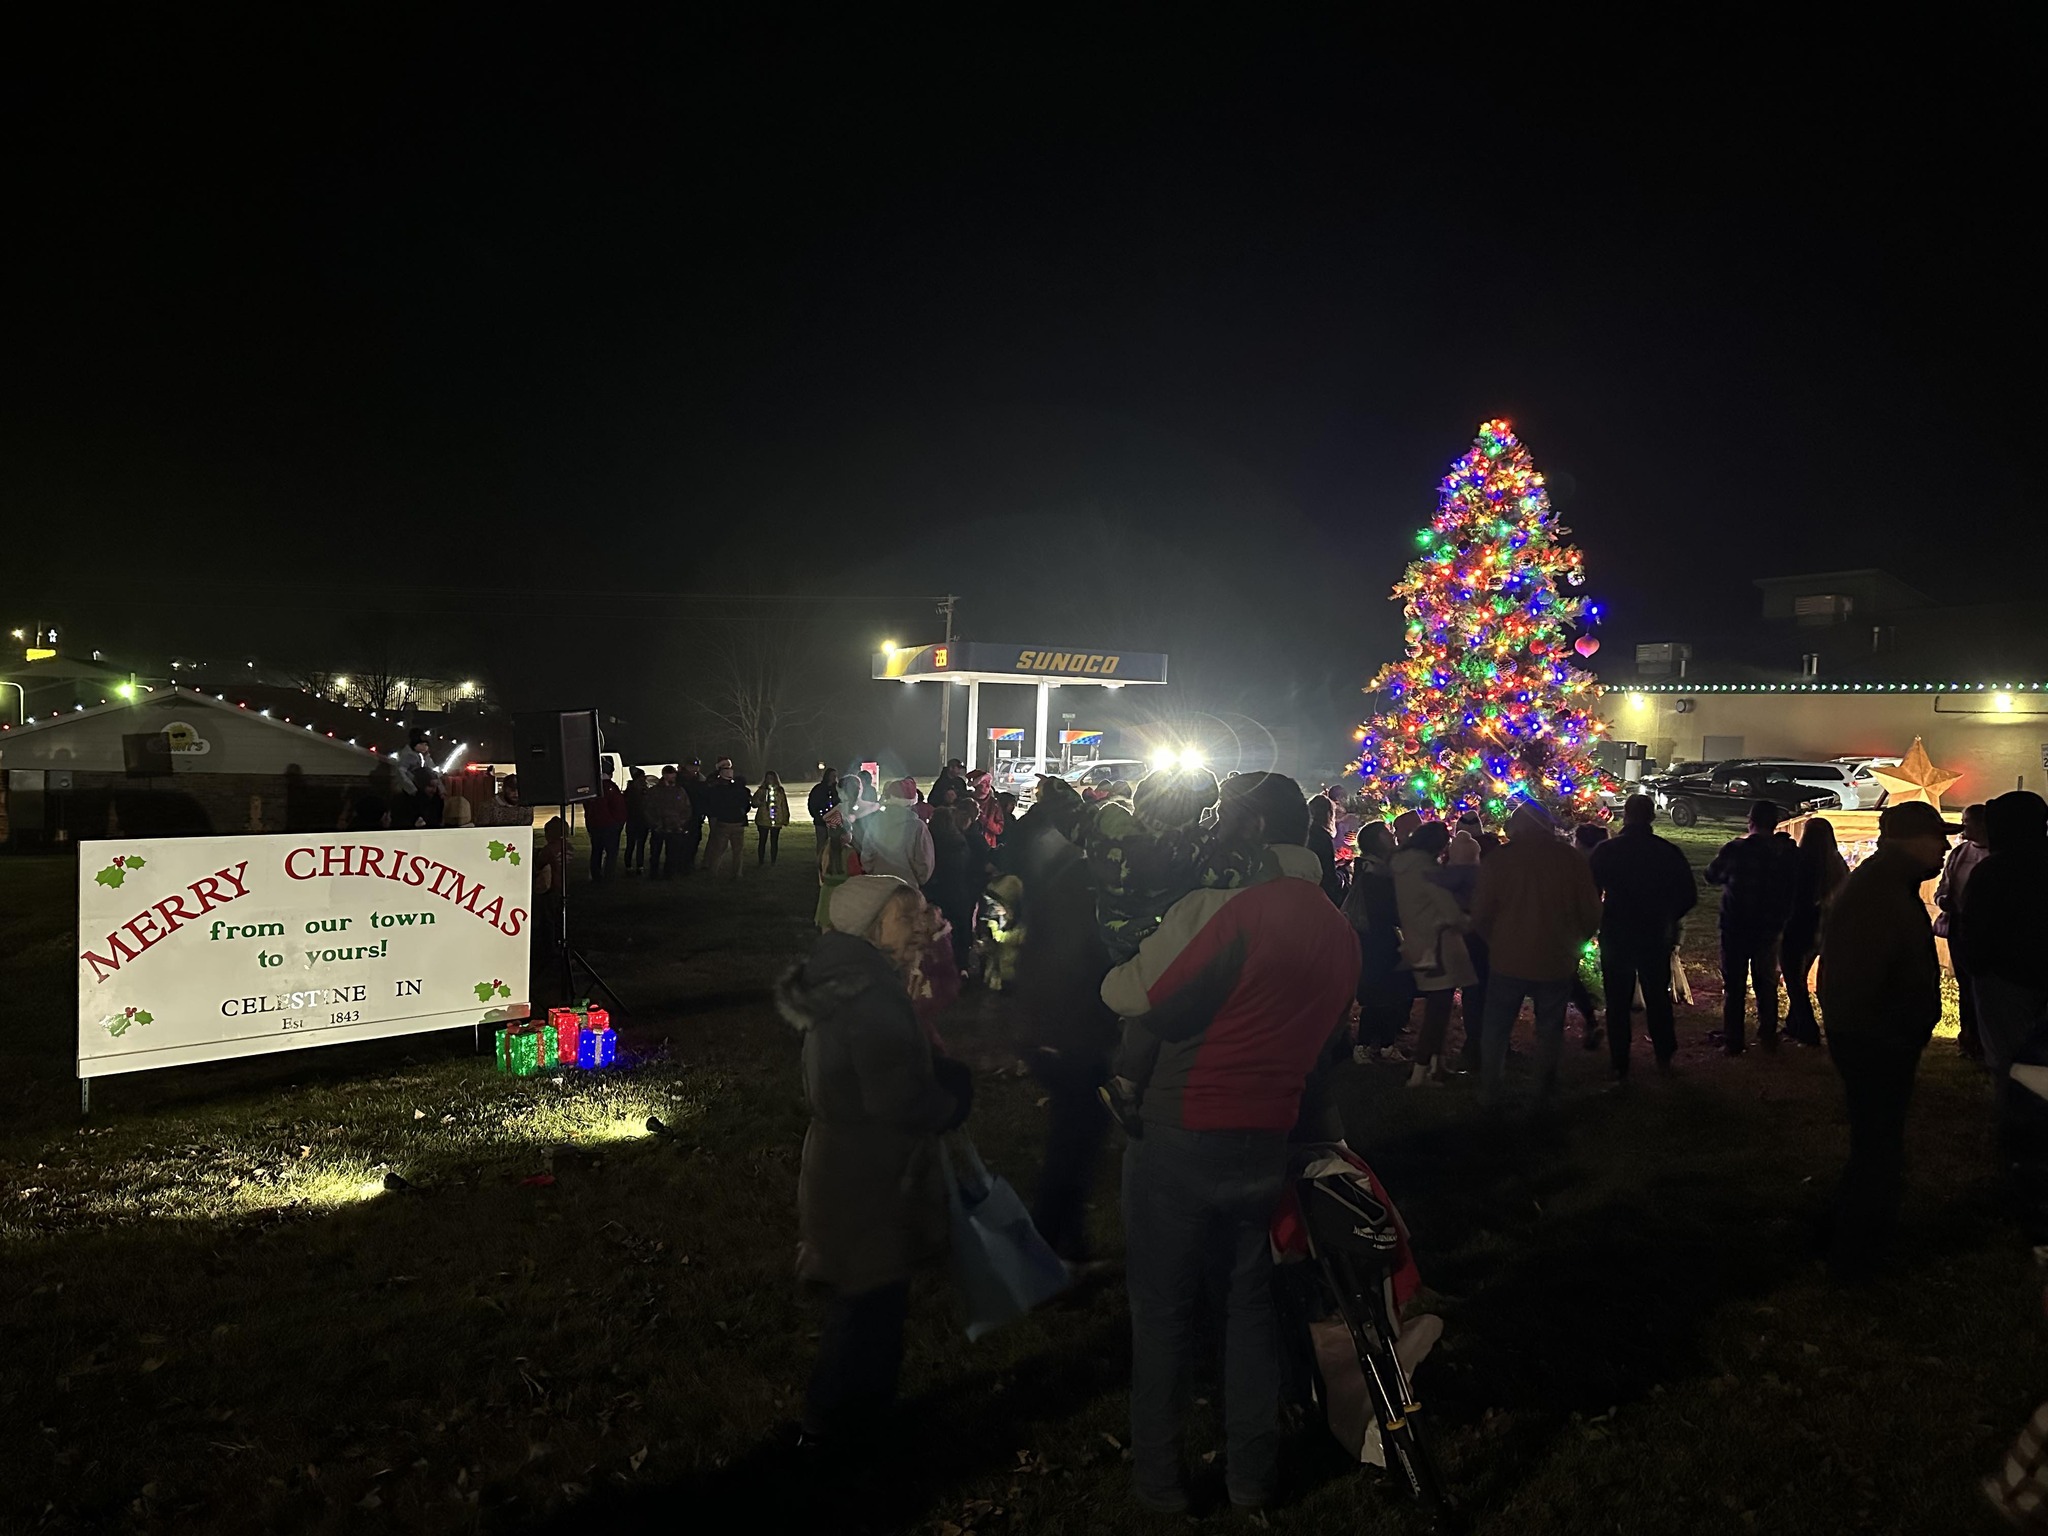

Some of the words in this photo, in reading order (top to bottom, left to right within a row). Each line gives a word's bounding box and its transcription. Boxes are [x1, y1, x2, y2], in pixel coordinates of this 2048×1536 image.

[1015, 650, 1121, 674] SUNOCO
[81, 861, 251, 984] MERRY
[284, 845, 529, 938] CHRISTMAS
[210, 920, 285, 941] from
[305, 917, 353, 934] our
[369, 911, 436, 929] town
[257, 949, 284, 968] to
[304, 939, 388, 969] yours!
[395, 979, 423, 997] IN
[330, 1010, 360, 1025] 1843
